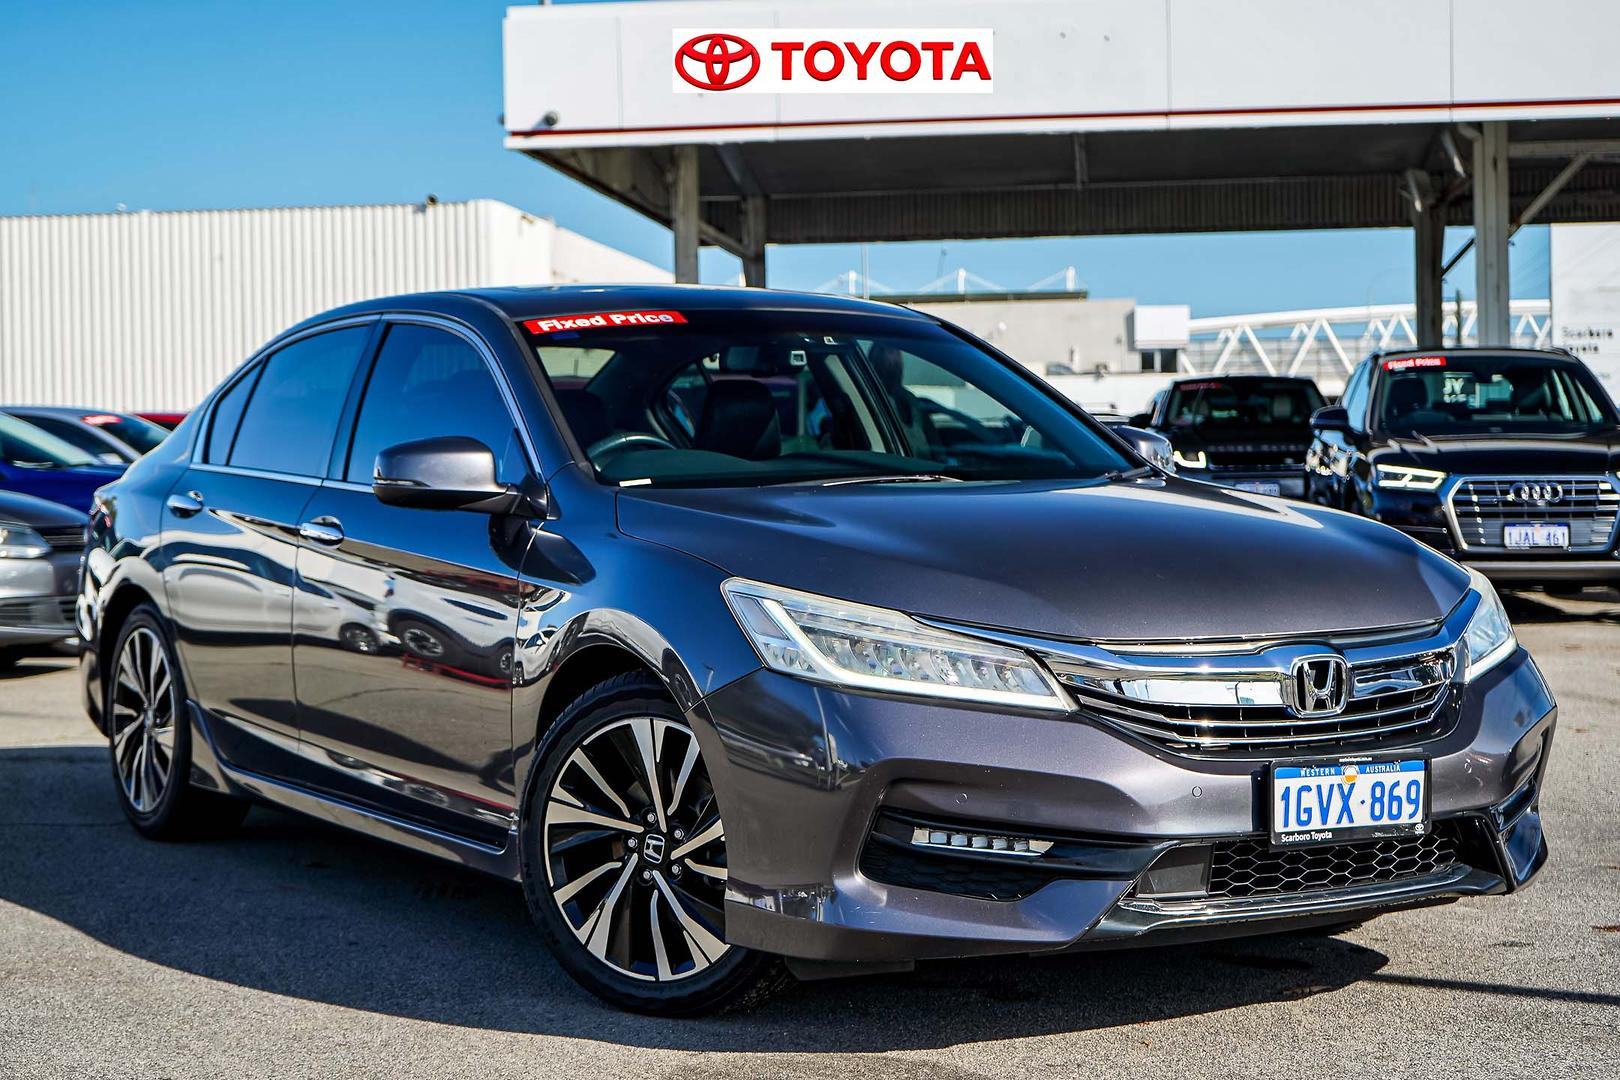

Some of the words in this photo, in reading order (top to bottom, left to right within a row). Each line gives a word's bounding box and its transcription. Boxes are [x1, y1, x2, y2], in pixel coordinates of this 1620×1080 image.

[537, 315, 607, 332] Fixed
[609, 312, 674, 325] Price
[1300, 766, 1336, 777] WESTERN
[1365, 763, 1401, 774] AUSTRALIA
[1281, 832, 1310, 842] Scarboro
[1310, 830, 1333, 841] Toyota
